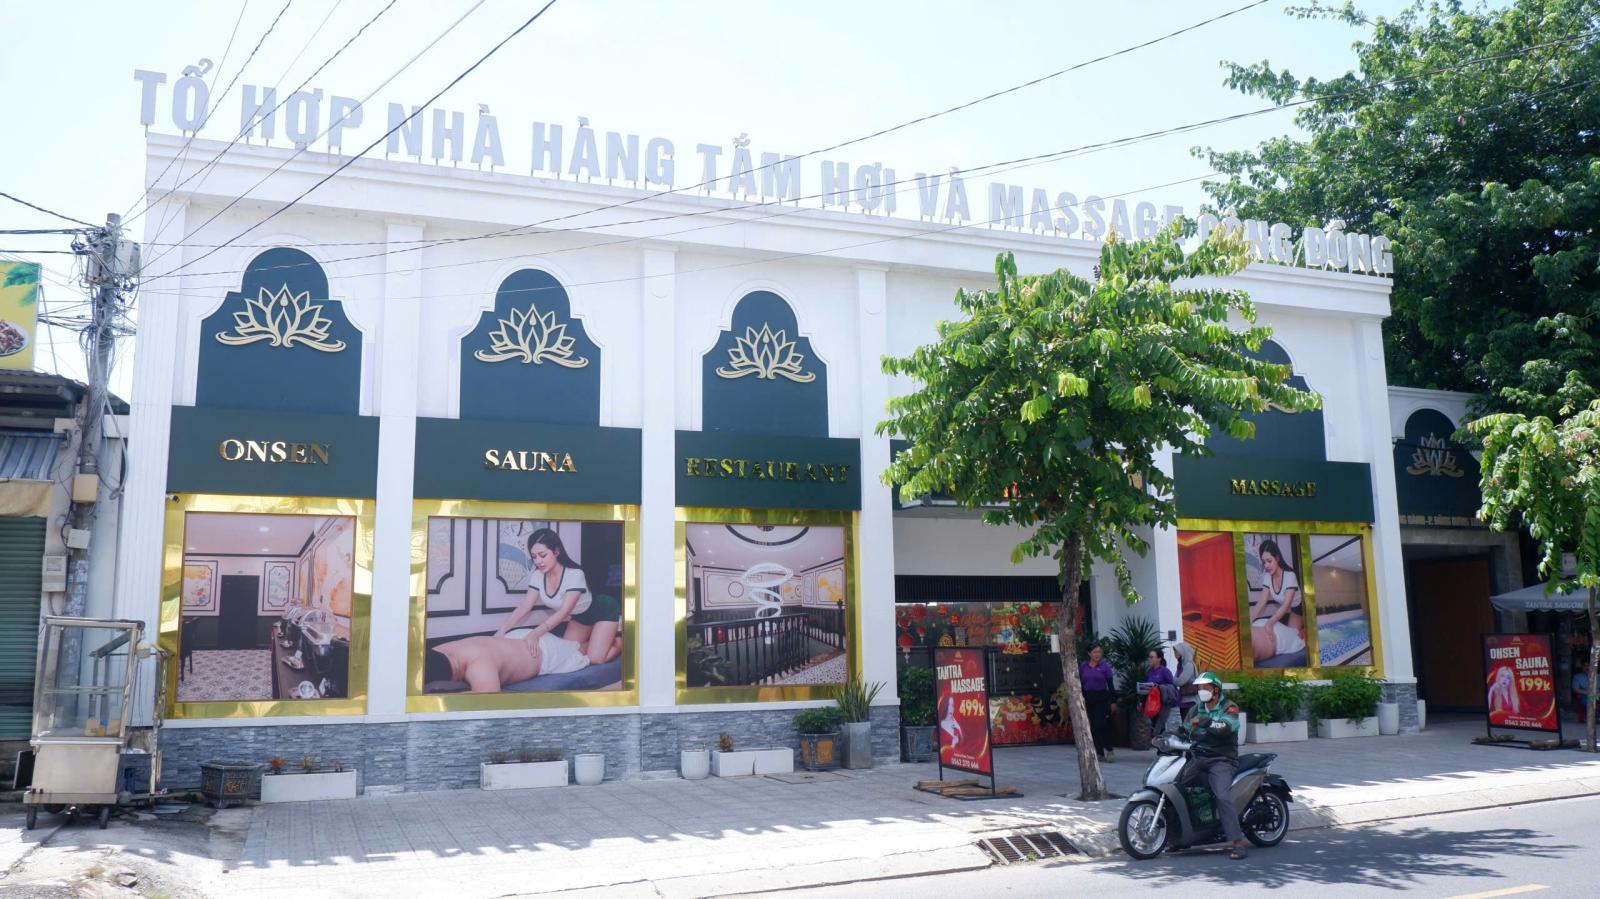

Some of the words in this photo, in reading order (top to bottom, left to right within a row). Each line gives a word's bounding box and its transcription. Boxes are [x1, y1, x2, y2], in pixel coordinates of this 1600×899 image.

[134, 58, 214, 132] TỔ
[386, 102, 505, 167] NHÀ
[532, 116, 675, 187] HÀNG
[696, 132, 801, 200] TẮM
[821, 160, 896, 213] HƠI
[915, 166, 971, 221] VÀ
[218, 438, 332, 465] ONSEN
[482, 448, 578, 473] SAUNA
[684, 456, 850, 483] RESTAURANT
[1231, 479, 1317, 497] MASSAGE
[1490, 647, 1520, 659] ONSEN
[1516, 656, 1548, 669] SAUNA
[936, 665, 962, 679] TANTRA
[951, 677, 985, 693] MASSAGE
